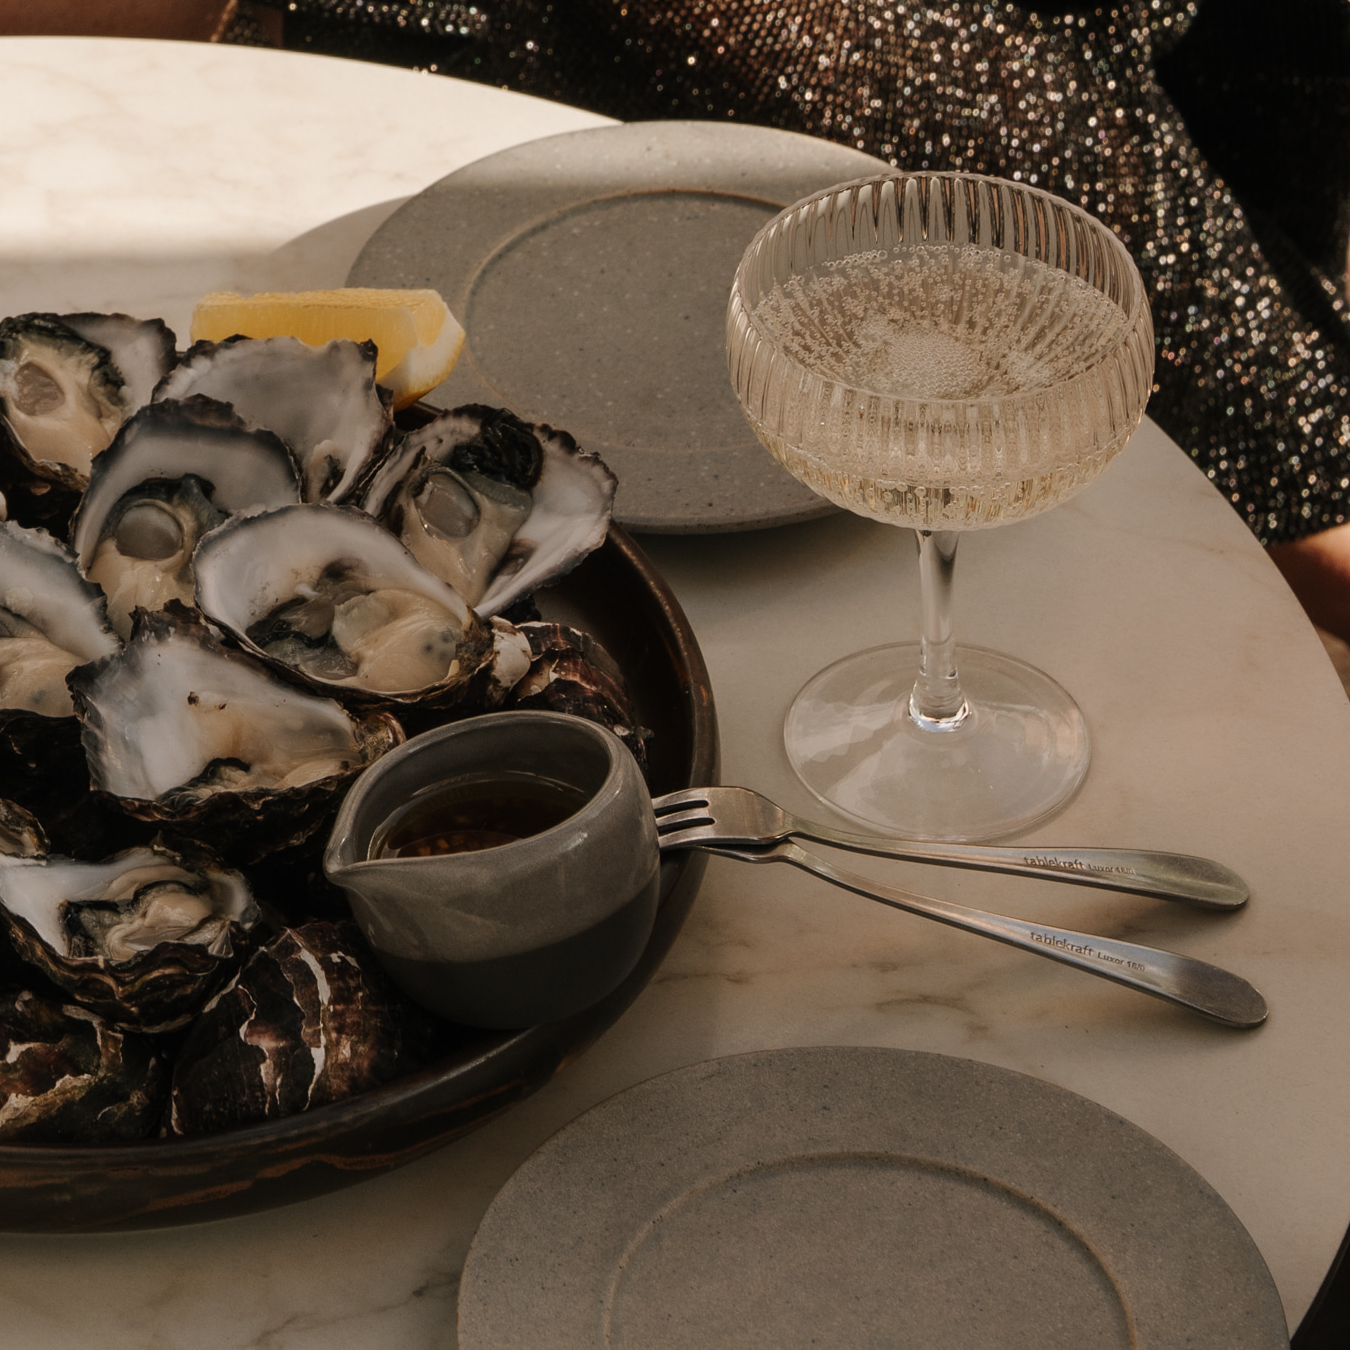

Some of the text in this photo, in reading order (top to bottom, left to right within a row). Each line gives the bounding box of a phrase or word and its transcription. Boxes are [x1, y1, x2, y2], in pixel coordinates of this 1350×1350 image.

[1023, 855, 1086, 870] tablekraft
[1088, 863, 1115, 873] Luxor
[1030, 931, 1094, 957] tablekraft
[1097, 951, 1125, 966] Luxor
